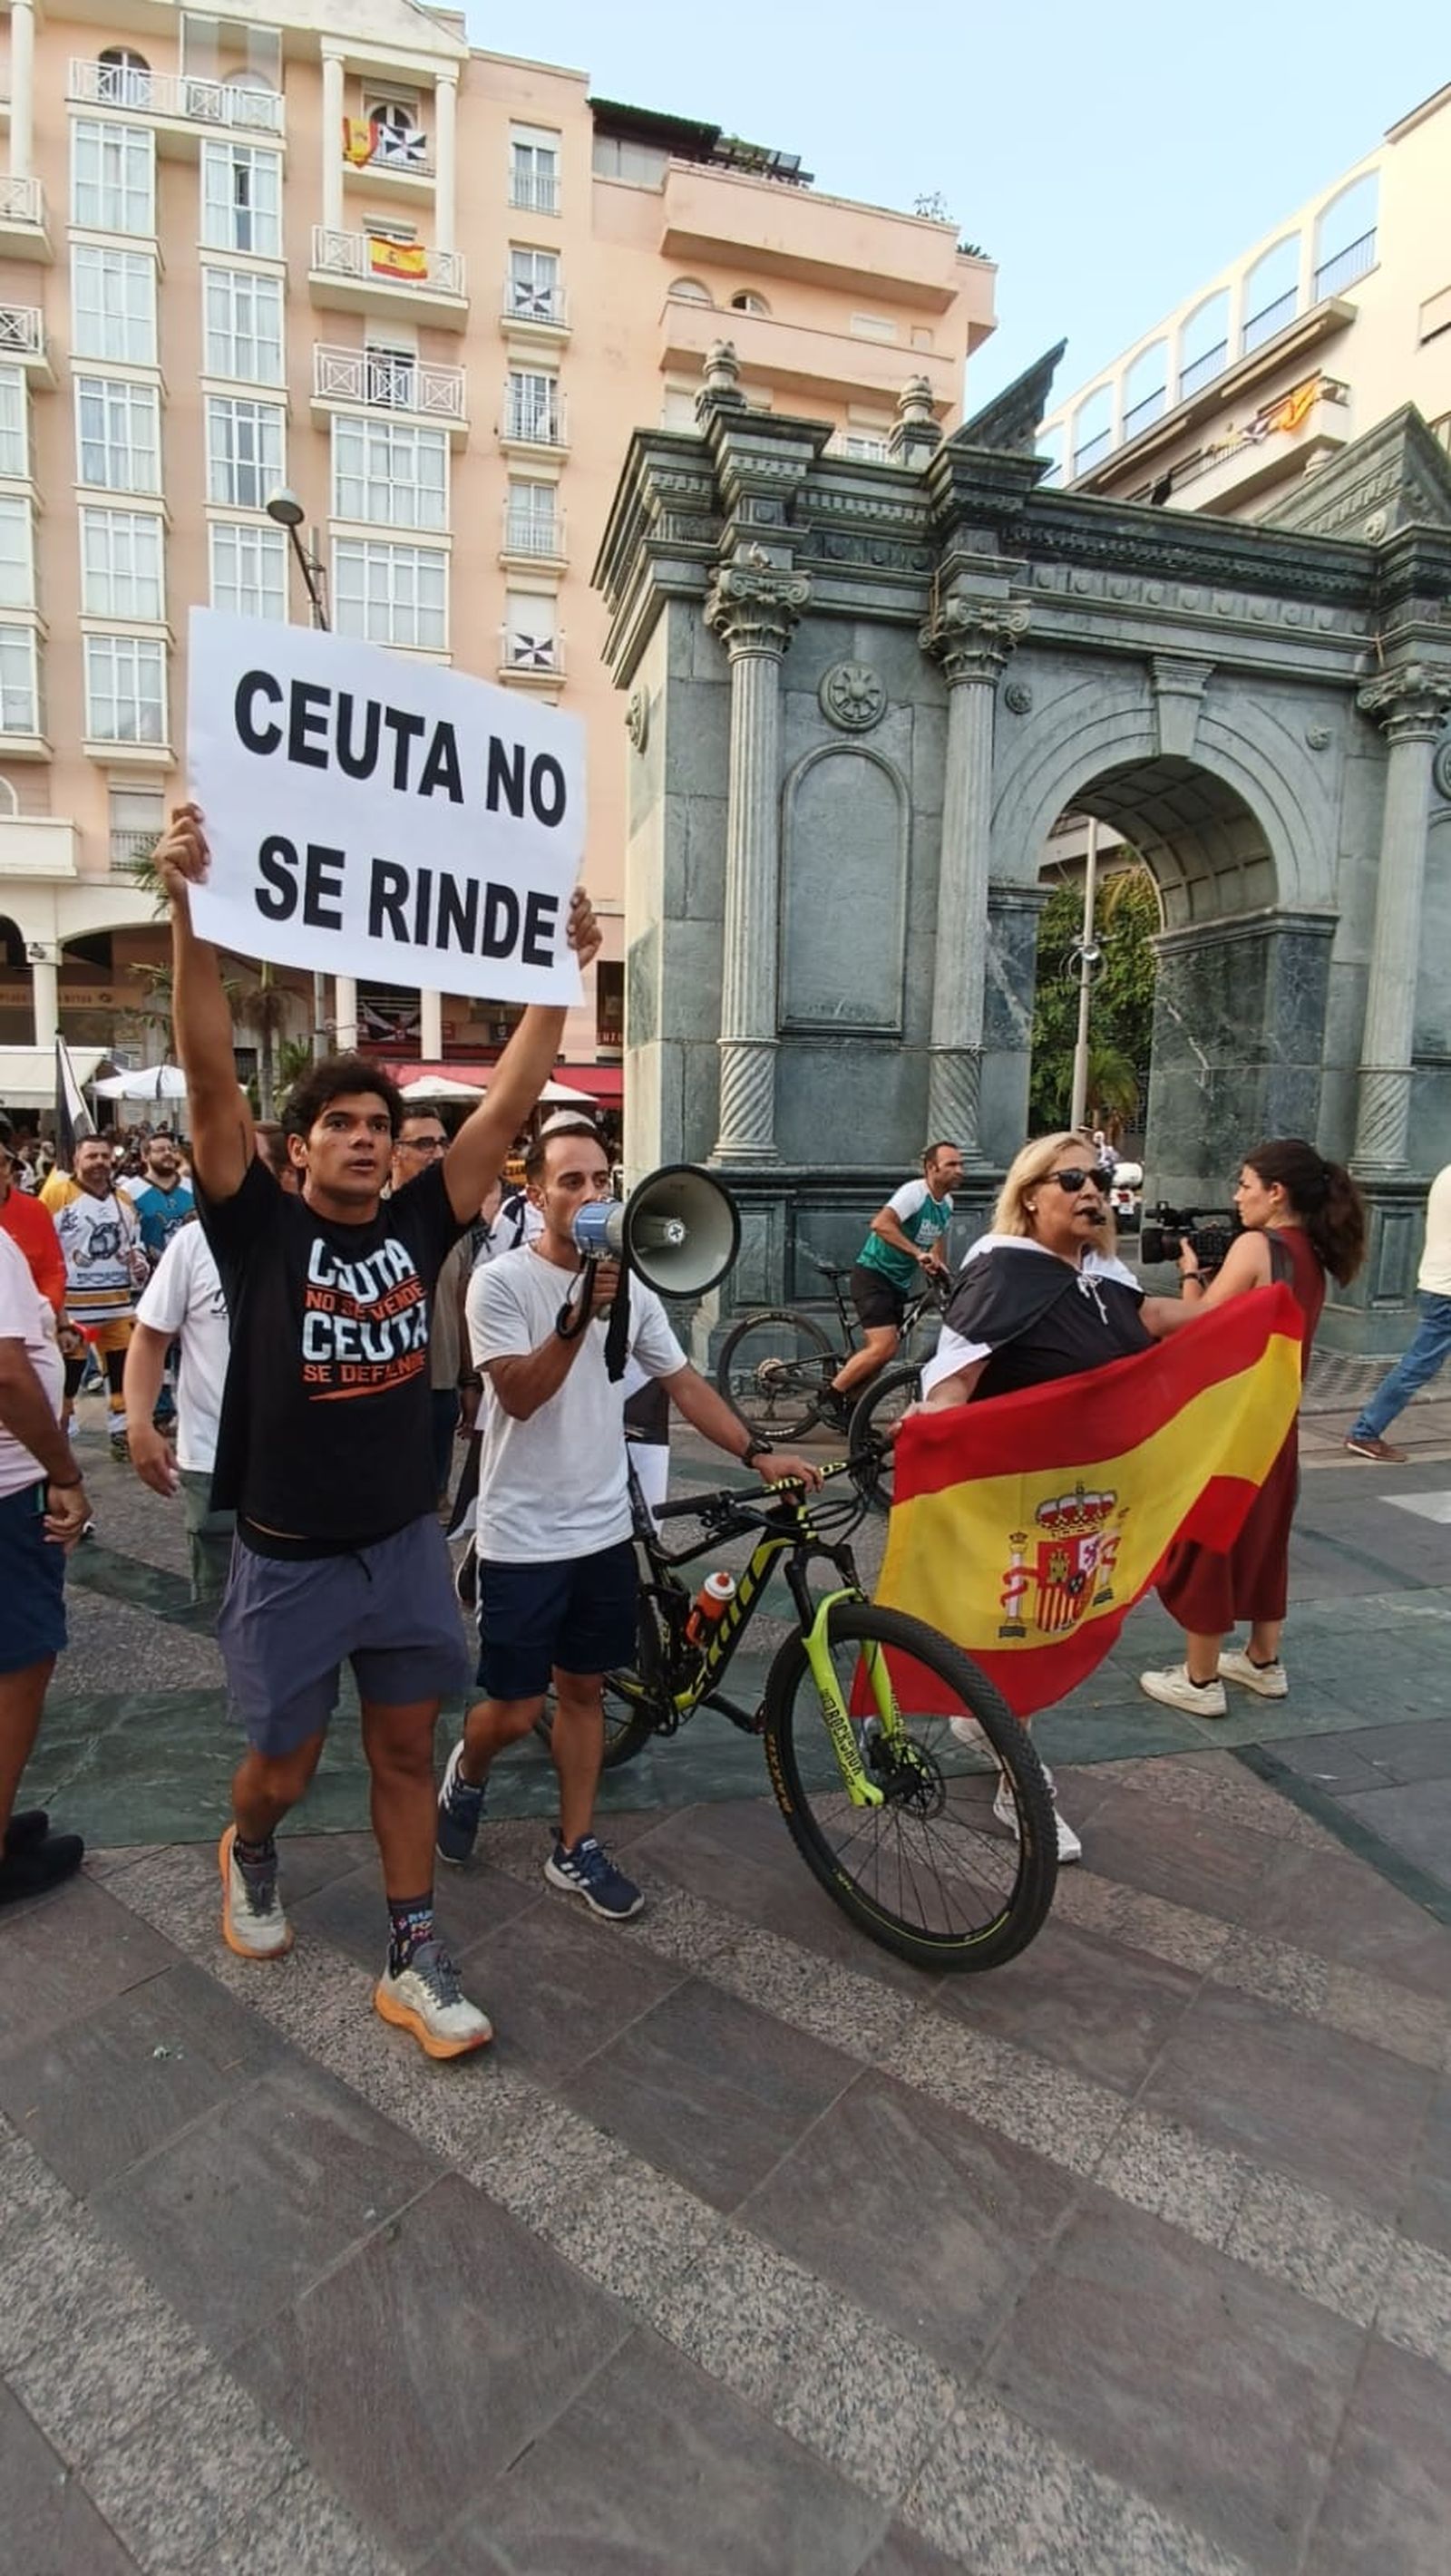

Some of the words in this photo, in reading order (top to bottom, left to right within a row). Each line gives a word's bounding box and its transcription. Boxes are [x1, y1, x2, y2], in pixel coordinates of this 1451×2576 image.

[234, 669, 464, 804] CEUTA
[486, 734, 567, 828] NO
[254, 834, 346, 931] SE
[368, 857, 559, 968] RINDE
[305, 1288, 336, 1312] NO
[341, 1298, 367, 1320] SE
[303, 1299, 428, 1362] CEUTA
[303, 1364, 333, 1383] SE
[763, 1462, 848, 1494] SYNOS
